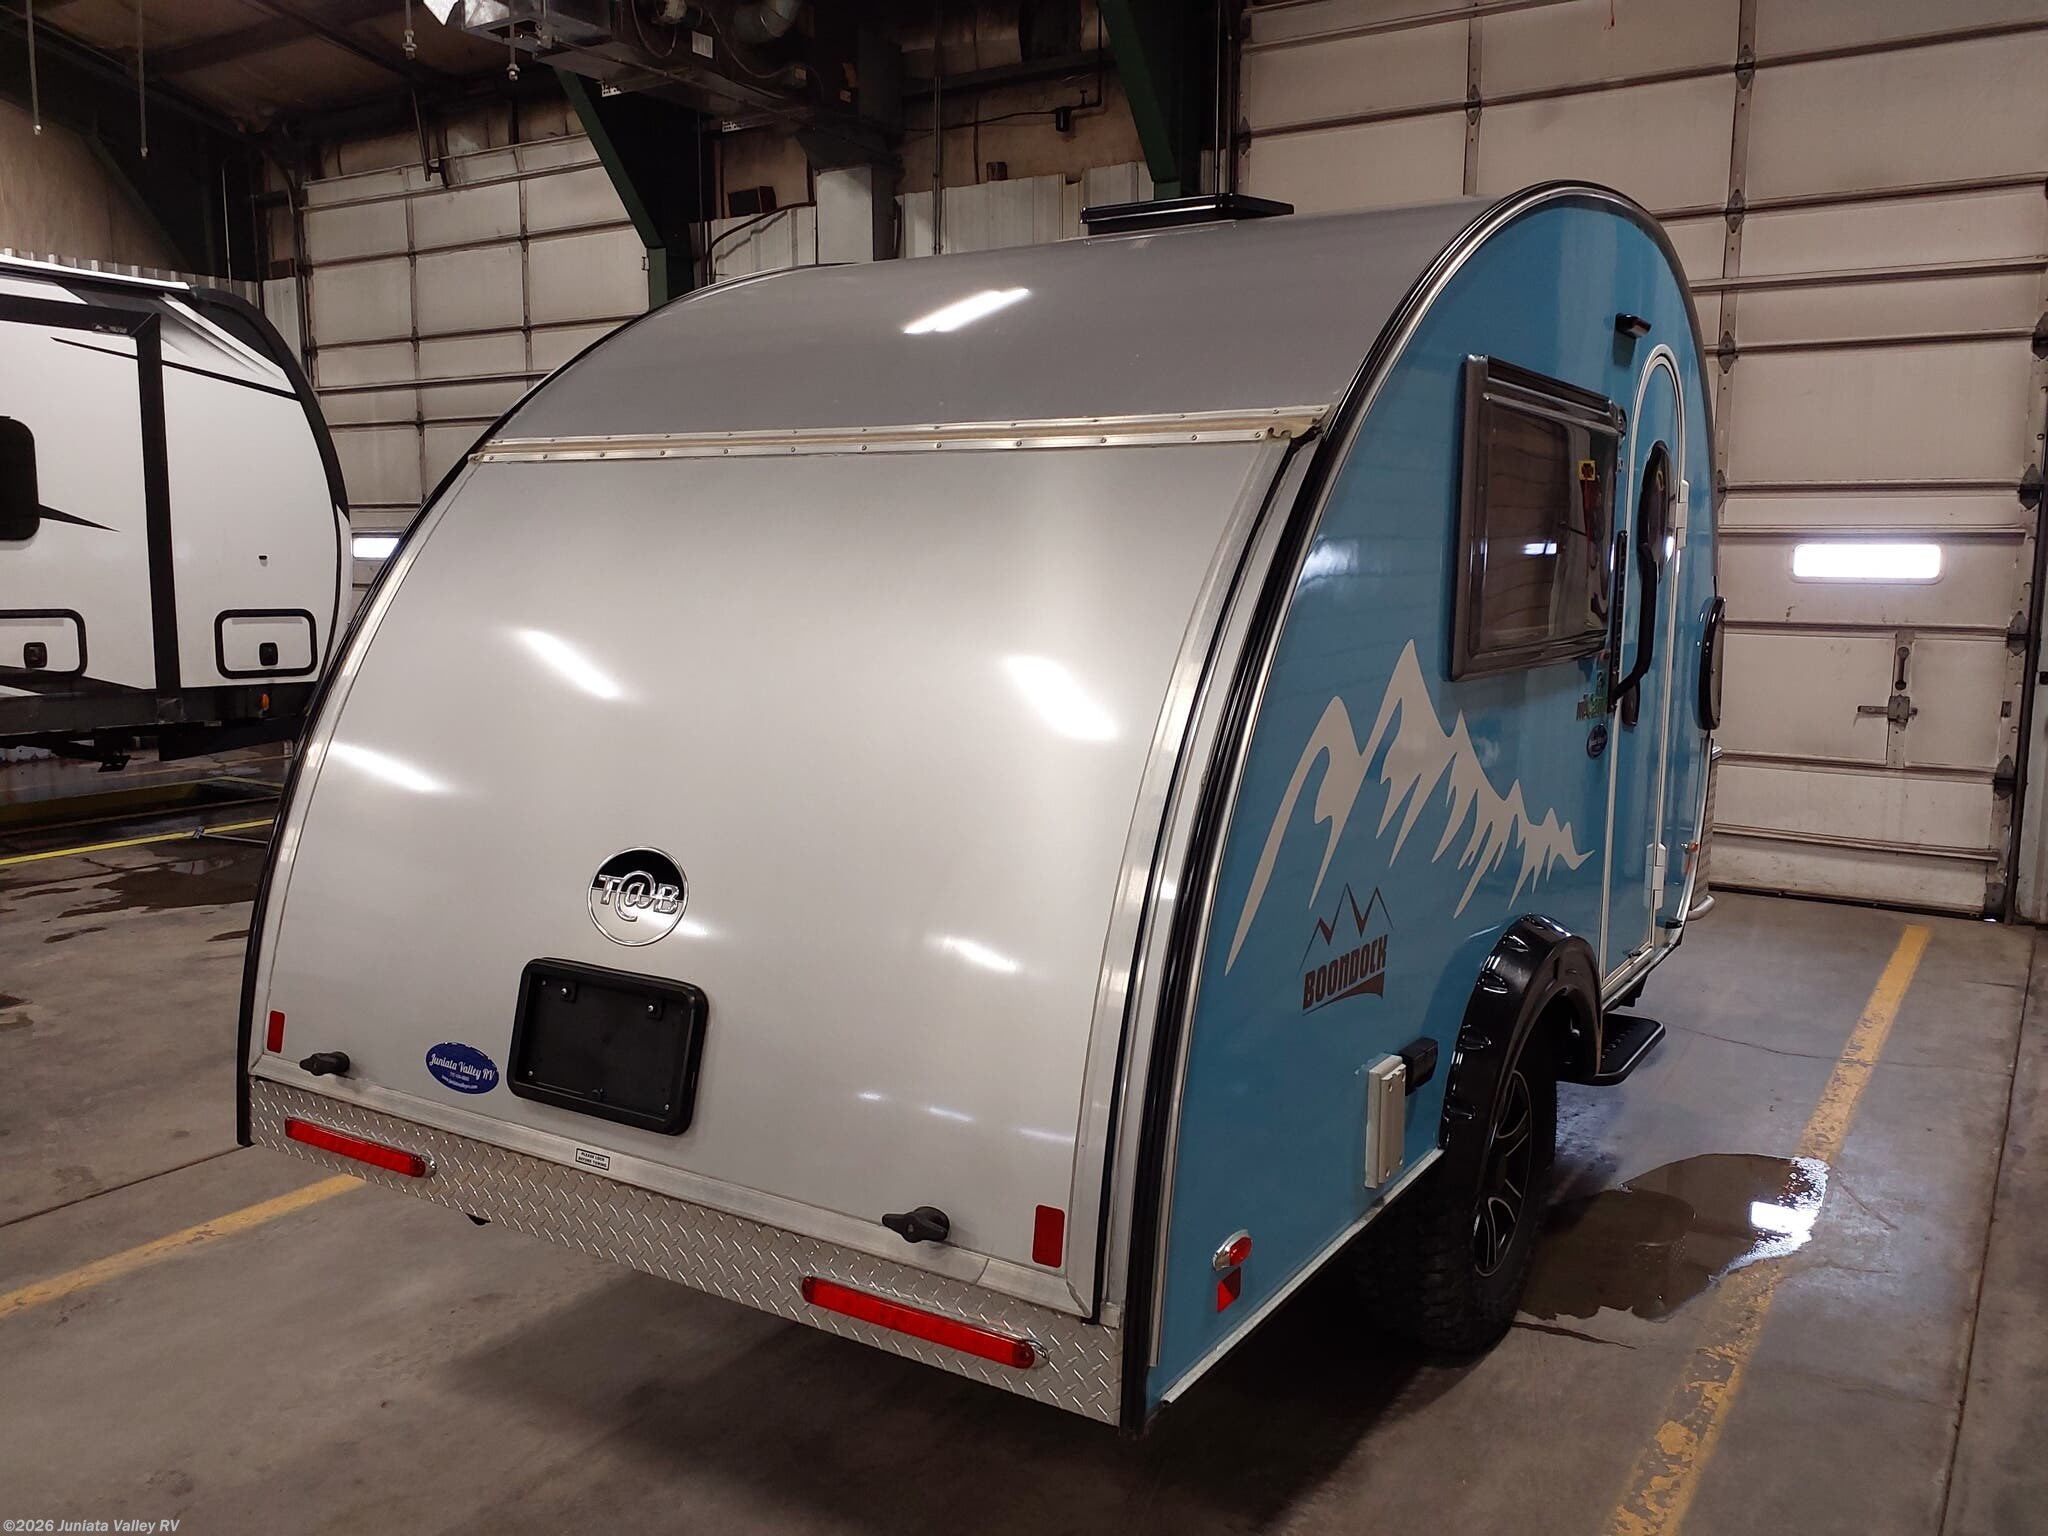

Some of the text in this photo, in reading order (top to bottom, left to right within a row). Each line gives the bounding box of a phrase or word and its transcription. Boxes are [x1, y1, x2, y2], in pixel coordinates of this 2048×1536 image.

[598, 870, 680, 922] T@B
[1303, 934, 1388, 1010] BOONDOCK
[429, 1053, 457, 1070] Juniata
[458, 1061, 481, 1080] Valley
[482, 1068, 495, 1080] RV
